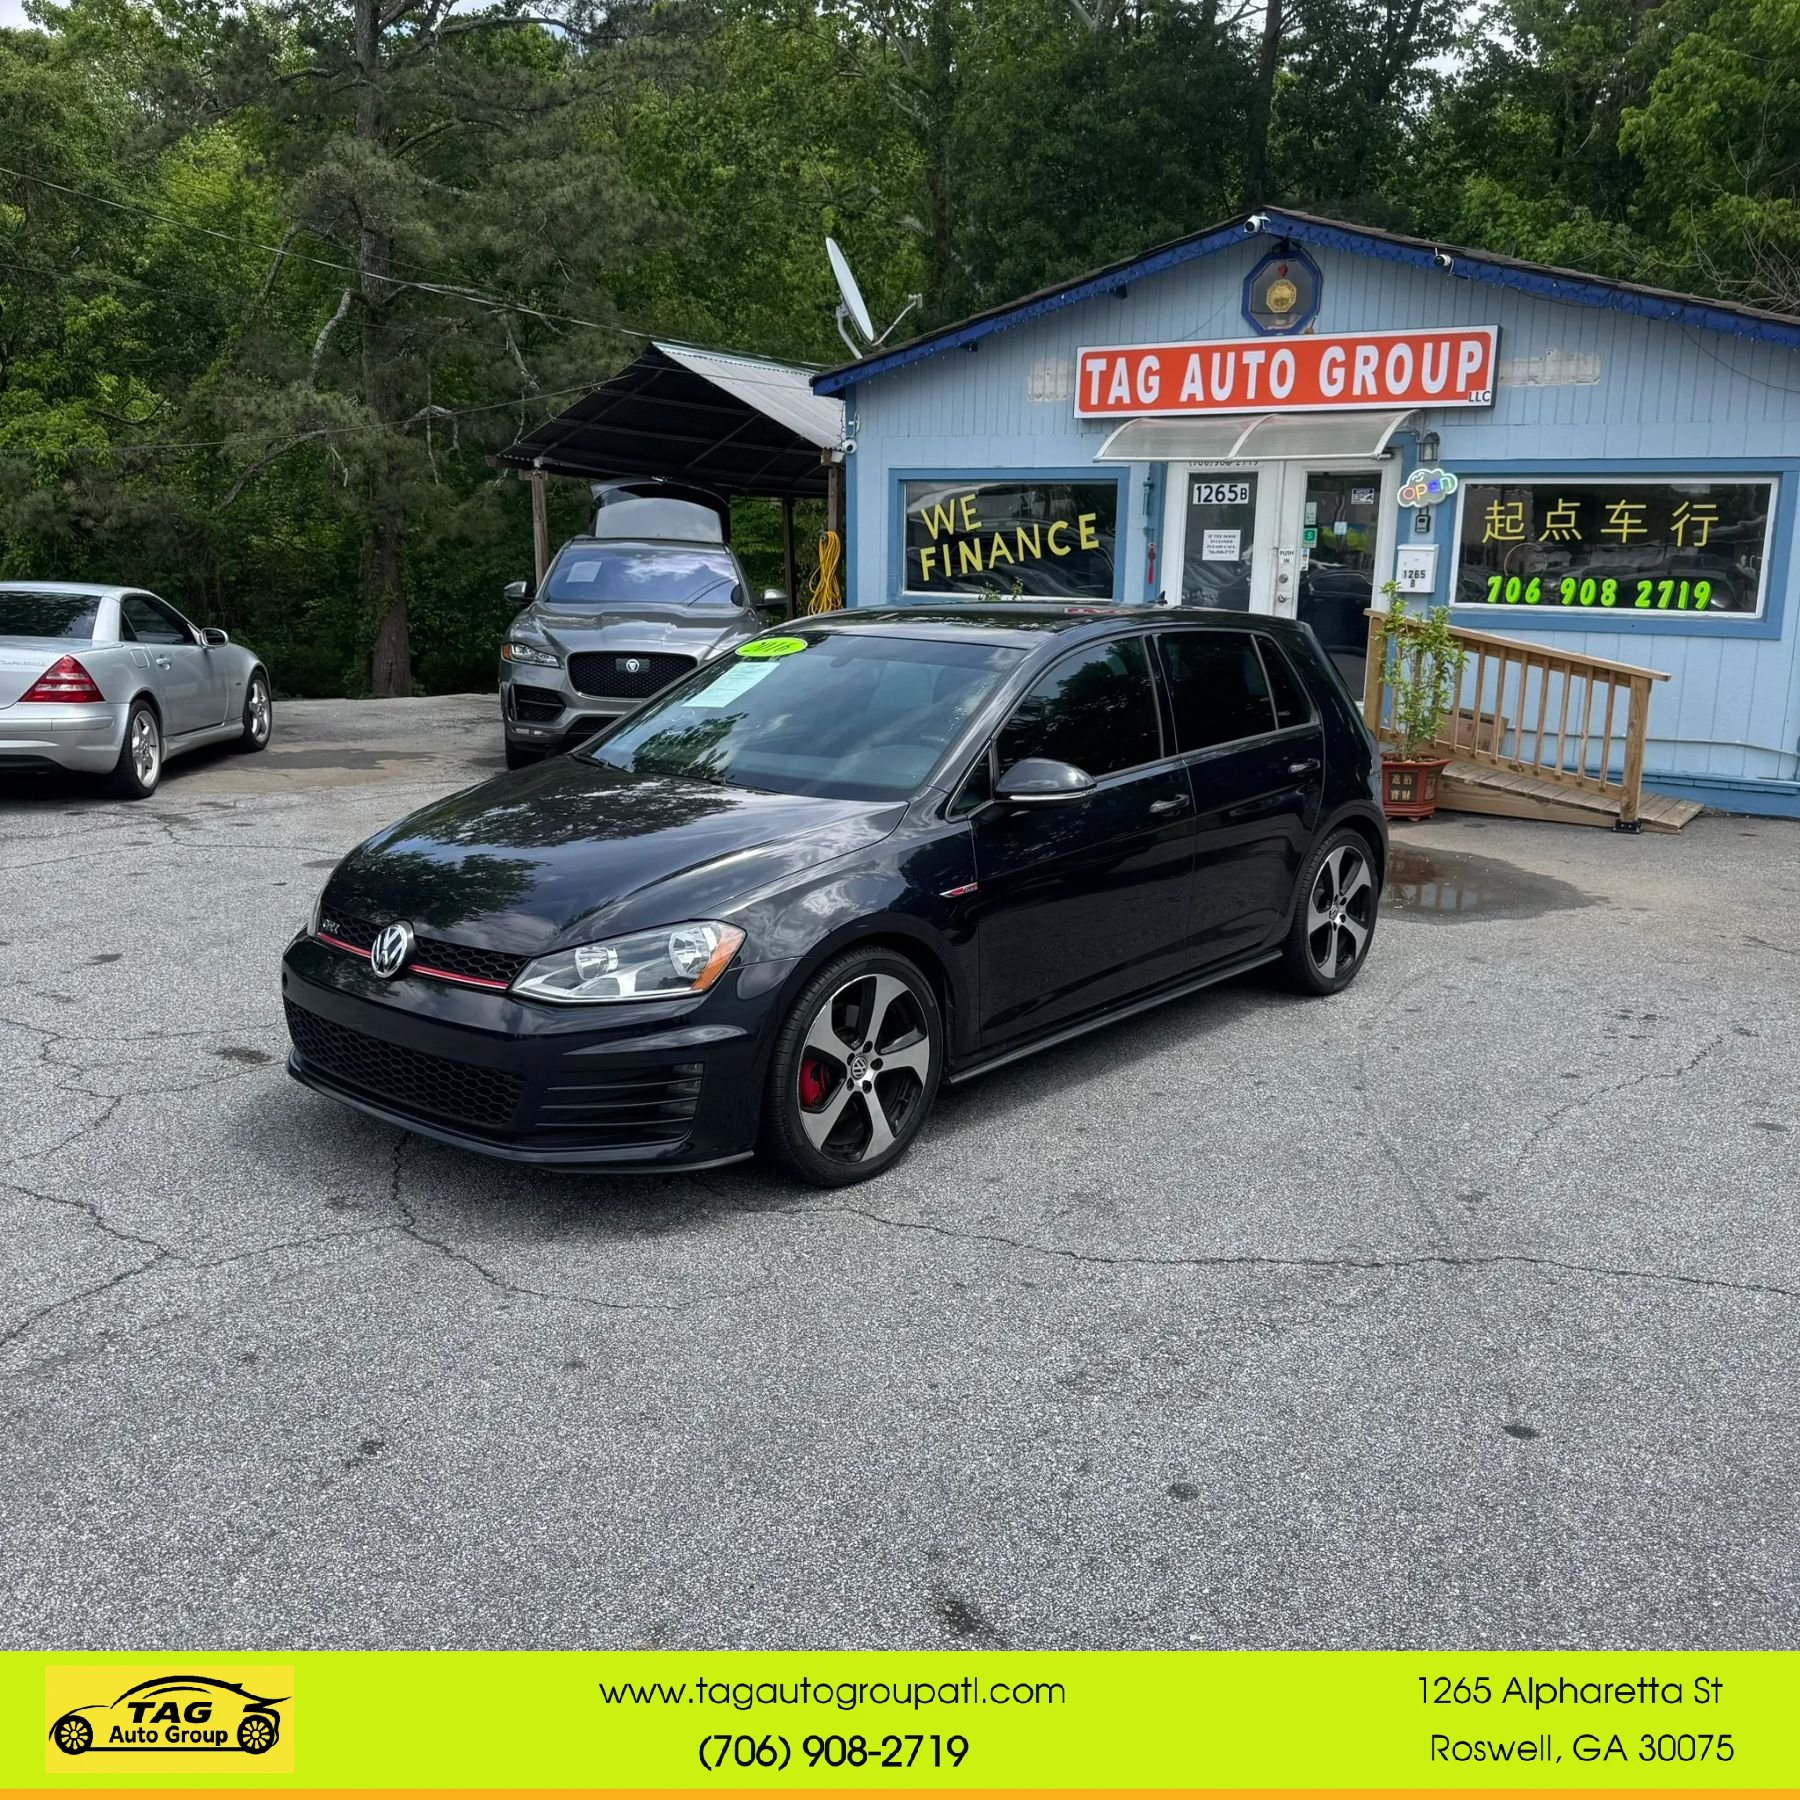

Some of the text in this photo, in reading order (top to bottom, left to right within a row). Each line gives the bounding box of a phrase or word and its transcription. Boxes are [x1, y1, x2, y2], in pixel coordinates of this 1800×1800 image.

[1086, 340, 1483, 406] TAG AUTO GROUP
[1468, 391, 1491, 402] LLC
[920, 494, 982, 540] WE
[1481, 498, 1719, 548] 起点车行
[919, 512, 1099, 582] FINANCE
[1403, 570, 1426, 580] 1265
[1487, 575, 1712, 610] 706 908 2719
